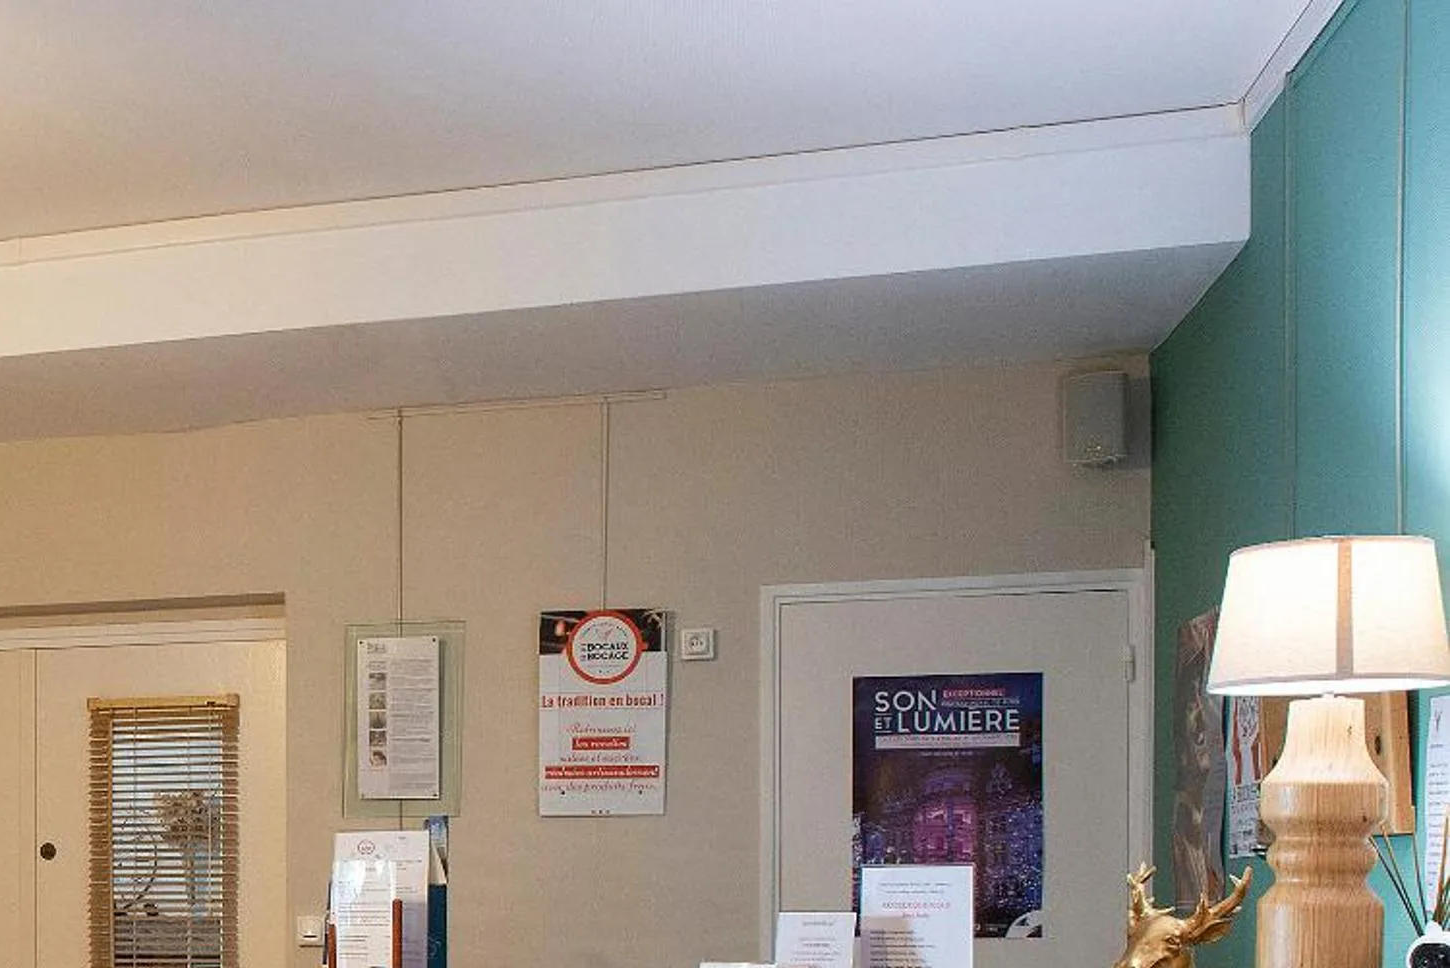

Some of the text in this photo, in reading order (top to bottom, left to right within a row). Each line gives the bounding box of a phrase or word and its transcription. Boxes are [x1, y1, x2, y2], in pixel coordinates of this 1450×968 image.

[542, 695, 554, 707] La
[558, 695, 606, 707] tradition
[609, 696, 624, 706] en
[626, 693, 656, 706] bocal
[875, 690, 937, 712] SON
[874, 716, 892, 730] ET
